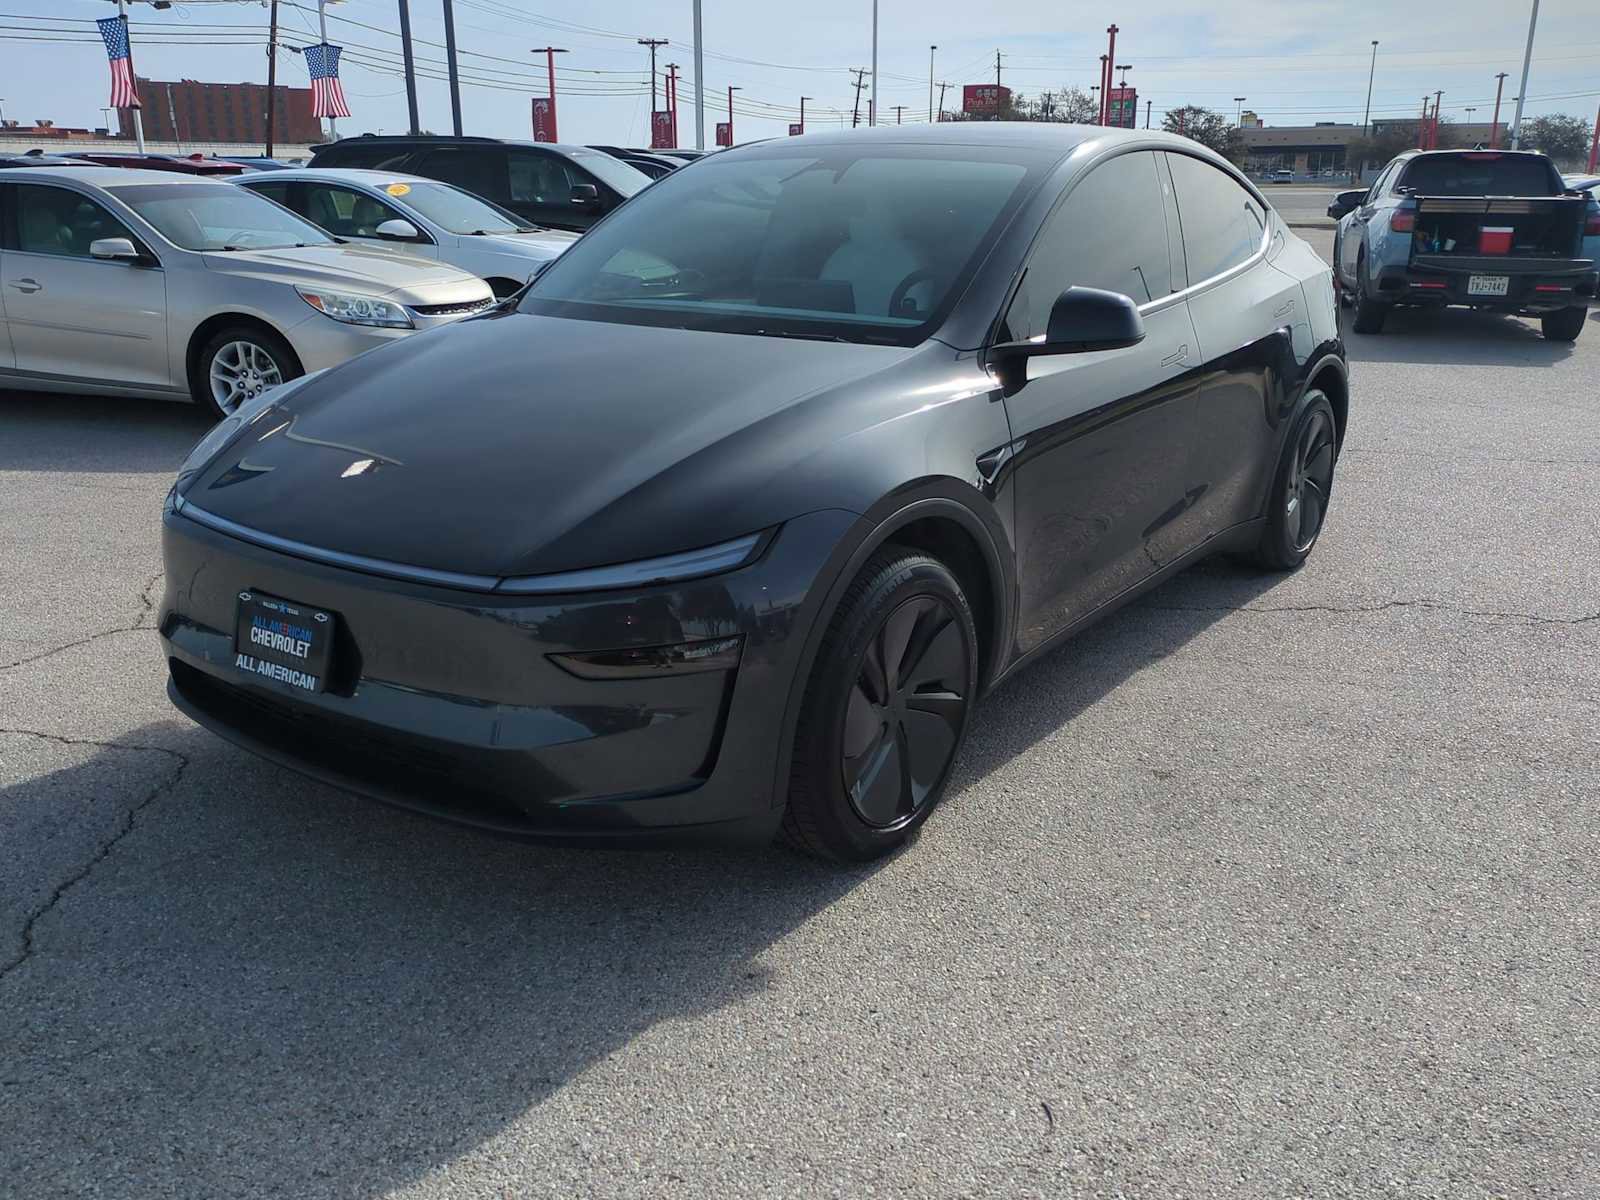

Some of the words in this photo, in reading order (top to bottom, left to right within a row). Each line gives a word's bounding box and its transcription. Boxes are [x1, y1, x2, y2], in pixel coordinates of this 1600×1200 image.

[251, 627, 311, 658] CHEVROLET
[253, 616, 268, 629] ALL
[268, 619, 312, 641] AMERICAN
[235, 654, 255, 672] ALL
[257, 660, 315, 690] AMERICAN
